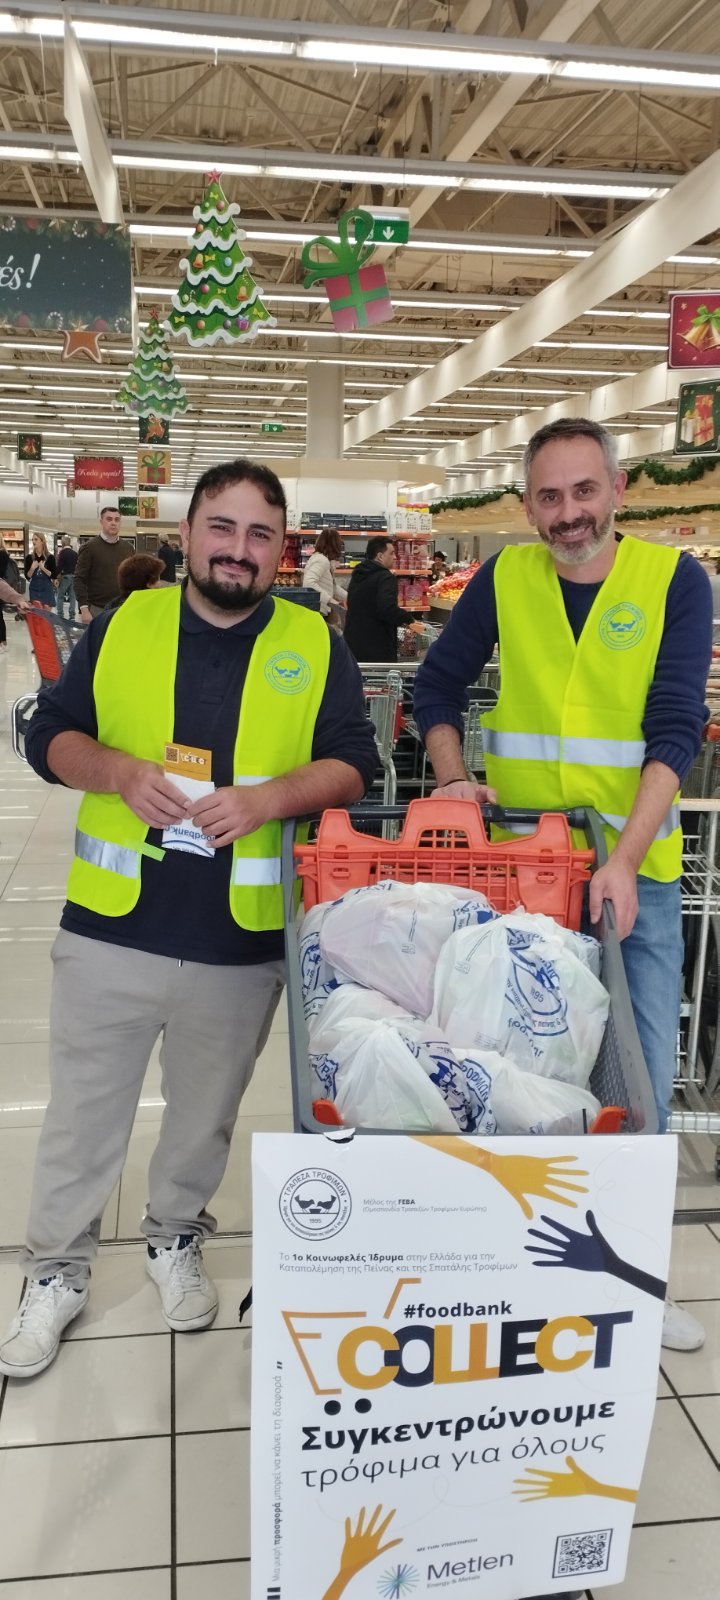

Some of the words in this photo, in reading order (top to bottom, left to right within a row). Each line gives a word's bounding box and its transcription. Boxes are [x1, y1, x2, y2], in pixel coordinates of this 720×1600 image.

[0, 253, 41, 290] ές!
[284, 1172, 310, 1197] ΤΡΑΠΕΖΑ
[312, 1171, 346, 1197] ΤΡΟΦΙΜΩΝ
[279, 1252, 290, 1260] Το
[306, 1253, 366, 1263] Κοινωφελές
[368, 1253, 404, 1263] Ίδρυμα
[406, 1253, 428, 1262] στην
[429, 1252, 462, 1261] Ελλάδα
[463, 1253, 478, 1263] για
[480, 1252, 496, 1261] την
[279, 1264, 345, 1275] Καταπολέμηση
[347, 1265, 361, 1274] της
[364, 1264, 394, 1273] Πείνας
[412, 1265, 427, 1273] της
[429, 1263, 472, 1273] Σπατάλης
[473, 1262, 518, 1272] Τροφίμων
[404, 1301, 512, 1319] #foodbank
[272, 1375, 283, 1417] διαφορά
[274, 1419, 284, 1430] τη
[302, 1401, 616, 1455] Συγκεντρώνουμε
[272, 1433, 281, 1457] κάνει
[274, 1459, 281, 1470] να
[300, 1455, 440, 1493] τρόφιμα
[451, 1446, 500, 1472] για
[511, 1434, 606, 1460] όλους
[272, 1471, 283, 1501] μπορεί
[272, 1502, 283, 1545] προσφορά
[427, 1553, 514, 1581] Metlen
